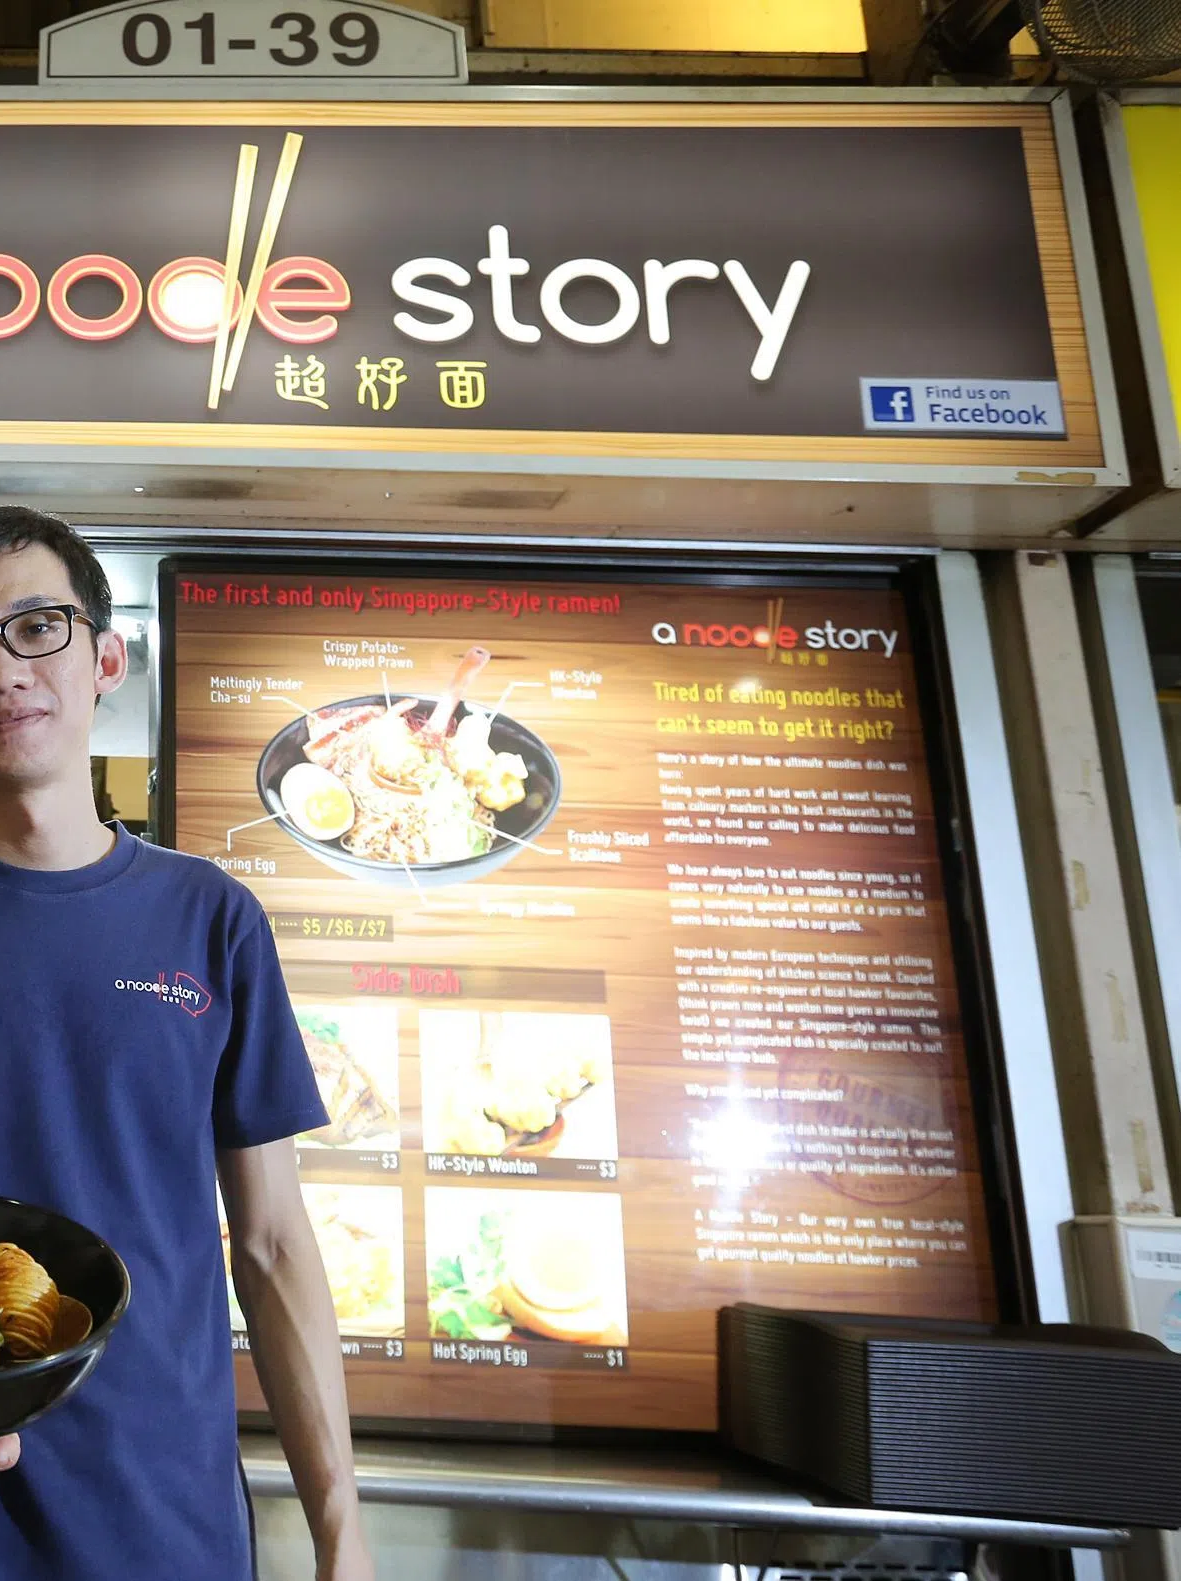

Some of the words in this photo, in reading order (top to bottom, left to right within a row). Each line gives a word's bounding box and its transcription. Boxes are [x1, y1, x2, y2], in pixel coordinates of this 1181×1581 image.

[122, 12, 380, 67] 01-39
[391, 224, 811, 382] story
[925, 386, 962, 399] Find
[967, 388, 986, 400] us
[990, 389, 1011, 401] on
[929, 402, 1048, 426] Facebook
[180, 581, 218, 604] The
[223, 583, 270, 606] first
[276, 584, 313, 607] and
[320, 586, 364, 613] only
[371, 587, 542, 618] Singapore-Style
[323, 639, 358, 656] Crispy
[361, 640, 406, 655] Potato-
[651, 621, 677, 645] a
[804, 619, 898, 659] story
[324, 654, 375, 670] Wrapped
[378, 656, 413, 669] Prawn
[210, 676, 262, 692] Meltingly
[265, 677, 304, 691] Tender
[652, 681, 699, 703] Tired
[704, 683, 724, 703] of
[729, 686, 787, 710] eating
[790, 688, 861, 709] noodles
[866, 688, 906, 709] that
[210, 690, 252, 704] Cha-su
[656, 714, 702, 734] can't
[706, 718, 755, 735] seem
[759, 716, 779, 737] to
[783, 717, 817, 743] get
[818, 718, 835, 738] it
[838, 719, 895, 744] right?
[214, 857, 252, 874] Spring
[255, 858, 276, 875] Egg
[302, 917, 321, 936] $5
[351, 961, 403, 994] Side
[115, 979, 126, 990] a
[172, 983, 200, 1006] story
[381, 1154, 399, 1170] $3
[427, 1155, 485, 1176] HK-Style
[488, 1157, 538, 1175] Wonton
[598, 1162, 616, 1179] $3
[385, 1339, 403, 1358] $3
[432, 1341, 457, 1360] Hot
[459, 1343, 502, 1366] Spring
[503, 1344, 528, 1367] Egg
[606, 1349, 624, 1368] $1
